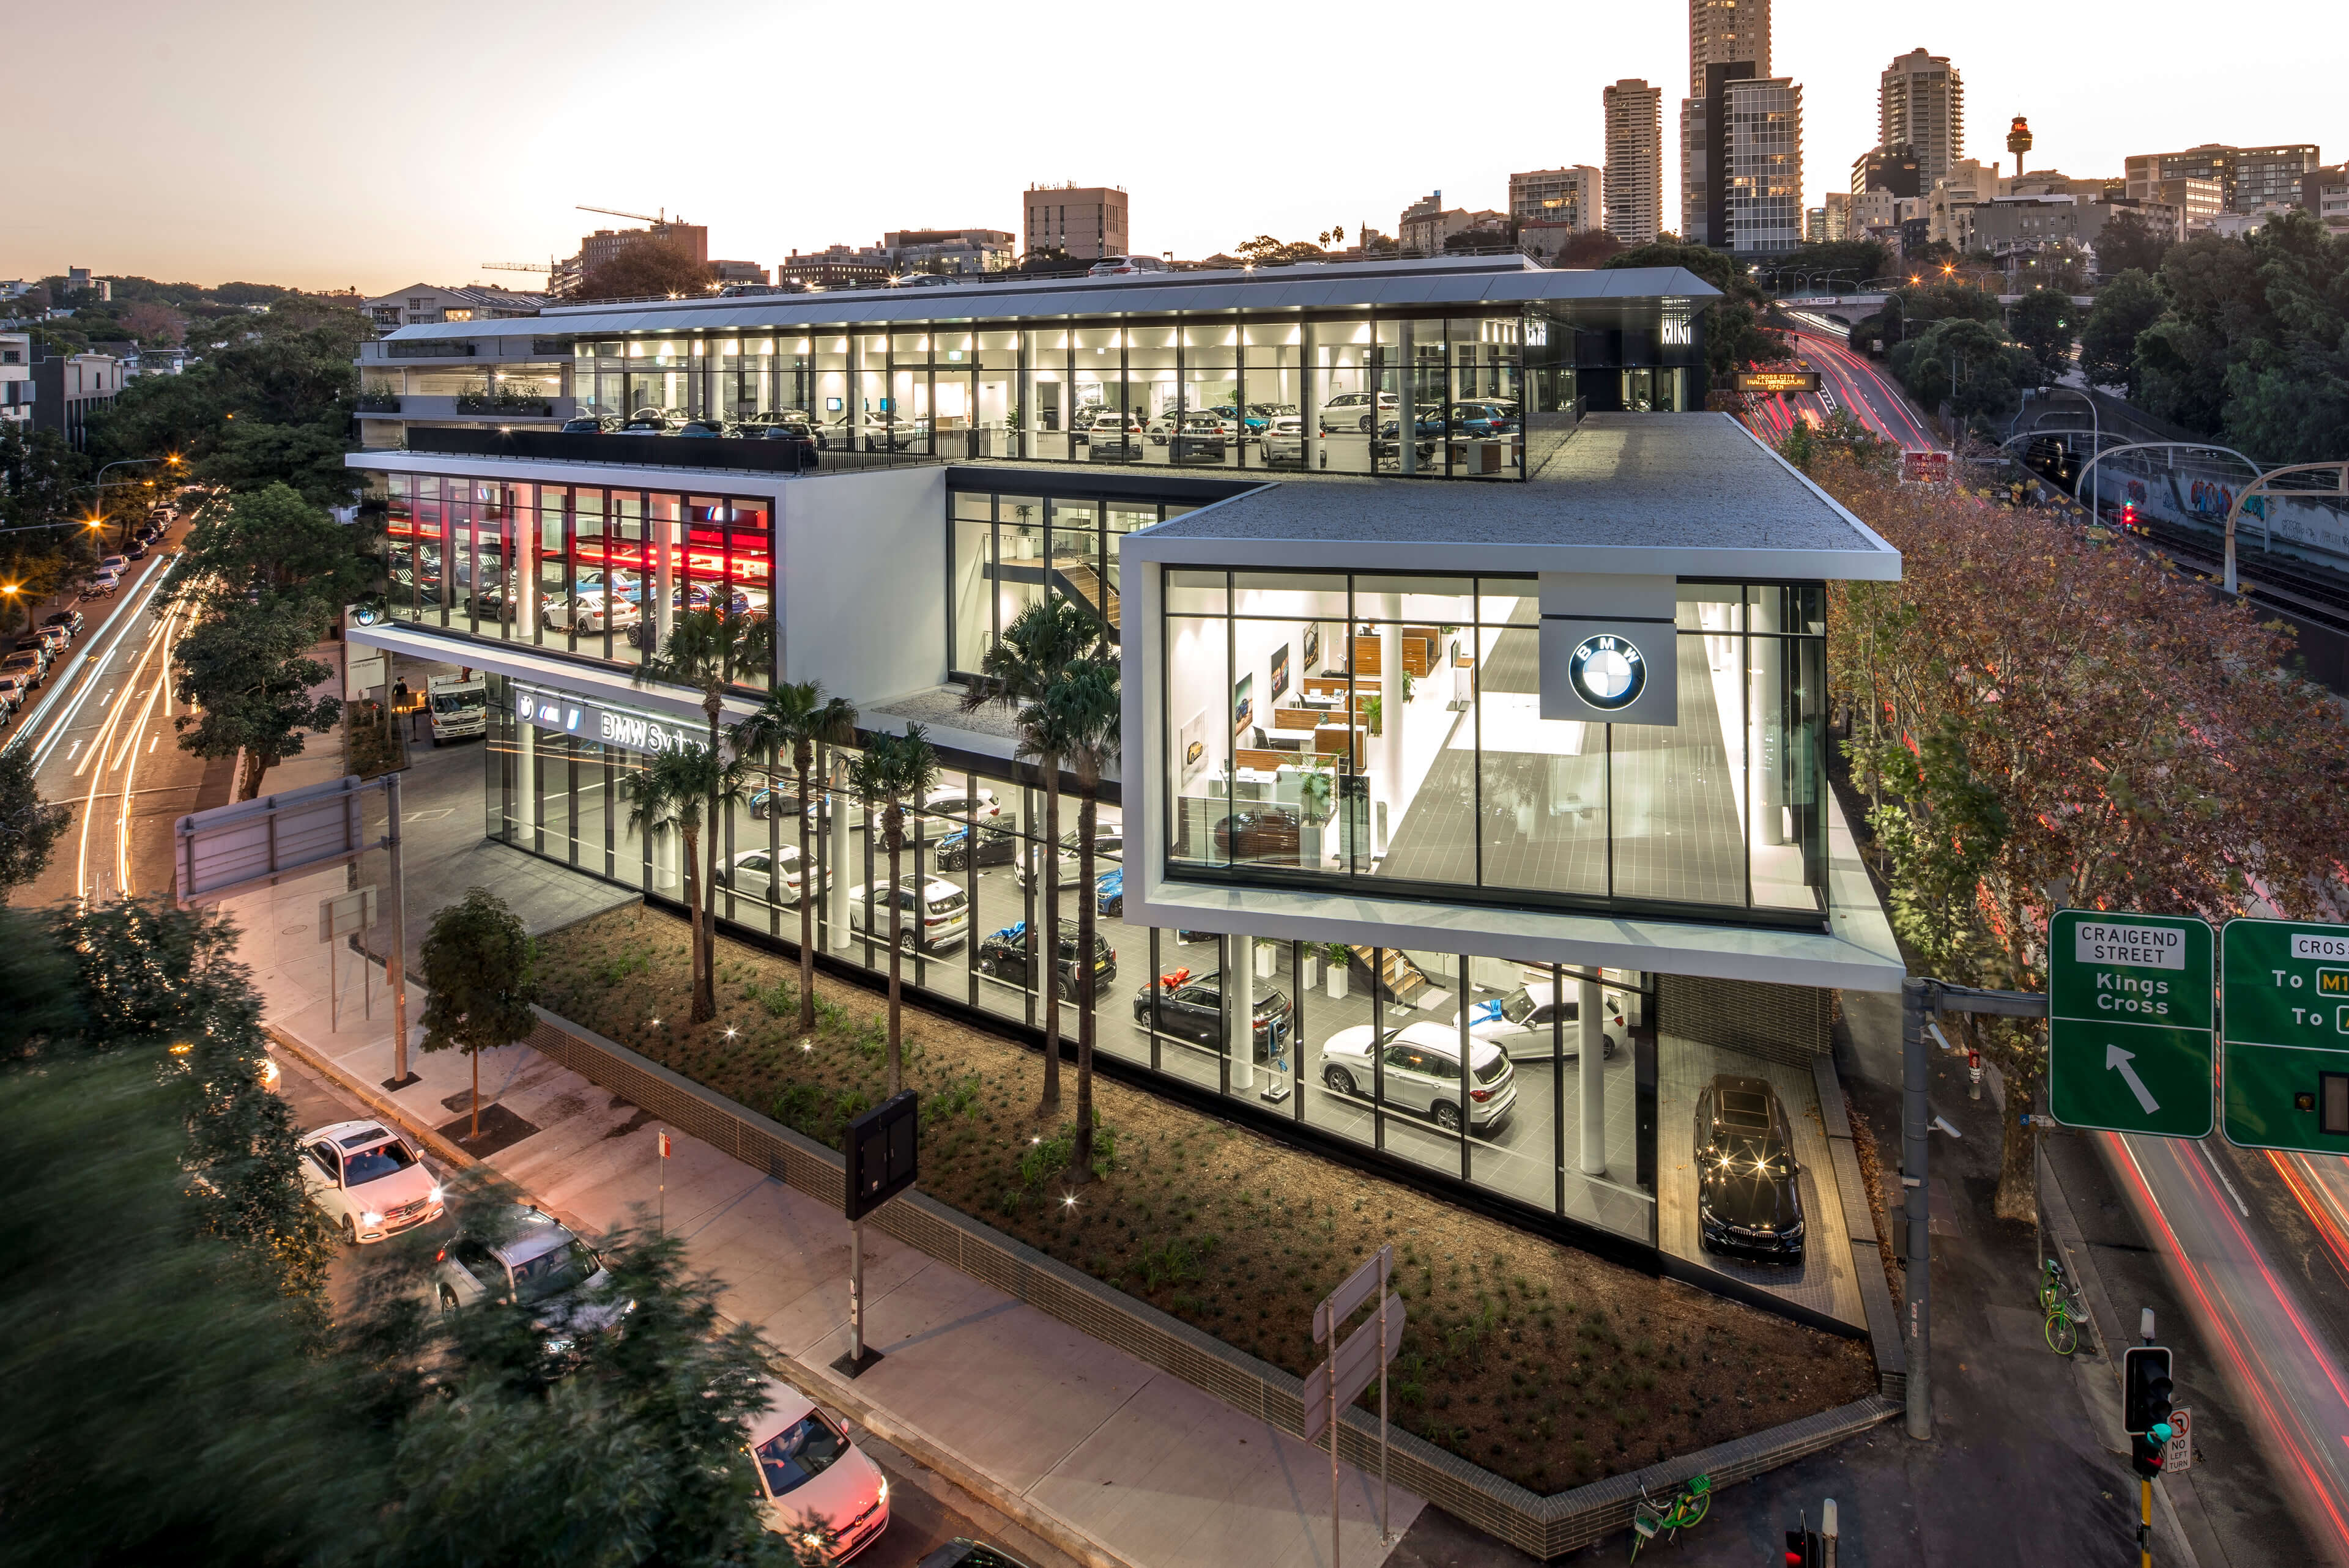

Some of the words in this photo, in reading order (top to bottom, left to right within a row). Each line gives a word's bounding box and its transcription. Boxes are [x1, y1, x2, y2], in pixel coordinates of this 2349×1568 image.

[1662, 325, 1691, 344] MINI
[1576, 637, 1640, 664] BMW
[601, 712, 647, 747] BMW
[2082, 926, 2178, 947] CRAIGEND
[2095, 945, 2165, 963] STREET
[2299, 939, 2349, 956] CROS
[2096, 972, 2169, 998] Kings
[2271, 969, 2303, 988] To
[2323, 974, 2349, 991] M1
[2097, 993, 2169, 1015] Cross
[2291, 1007, 2323, 1026] To
[2172, 1439, 2186, 1450] NO
[2170, 1450, 2188, 1460] LEFT
[2169, 1460, 2188, 1470] TURN
